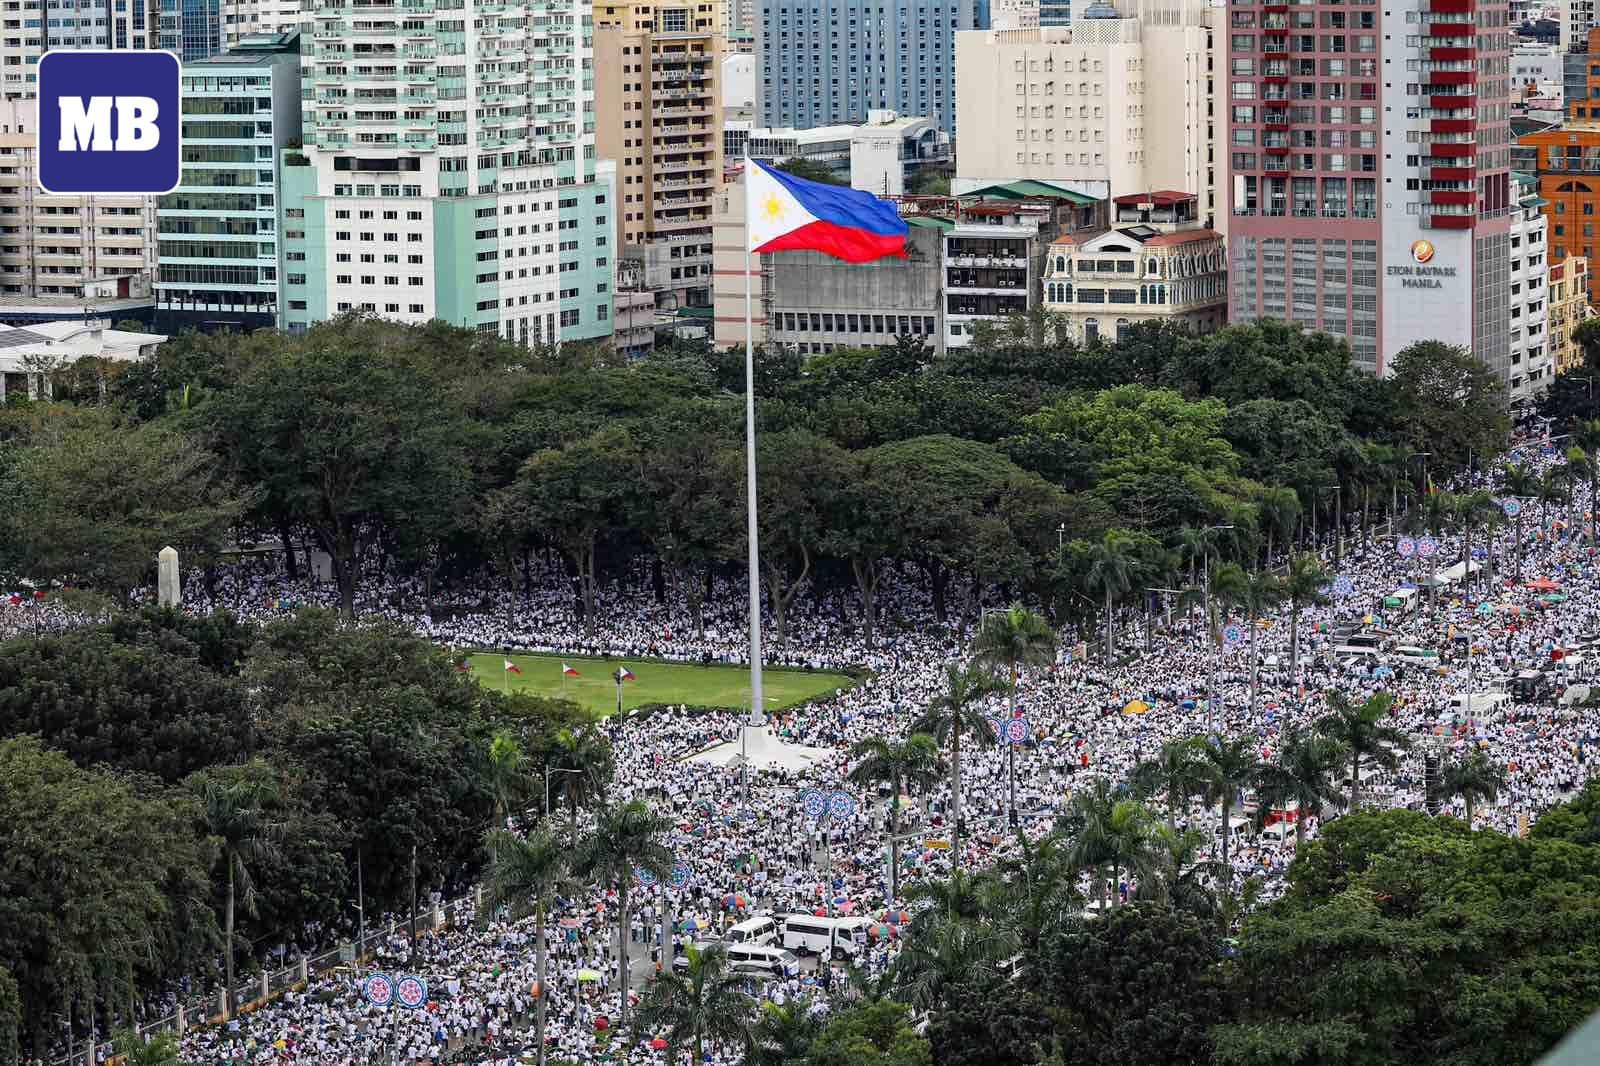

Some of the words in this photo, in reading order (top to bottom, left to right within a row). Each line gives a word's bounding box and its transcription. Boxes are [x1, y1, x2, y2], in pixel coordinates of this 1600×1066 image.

[1387, 266, 1412, 275] ETON
[1416, 266, 1456, 277] BAYPARK
[1402, 279, 1442, 288] MANILA
